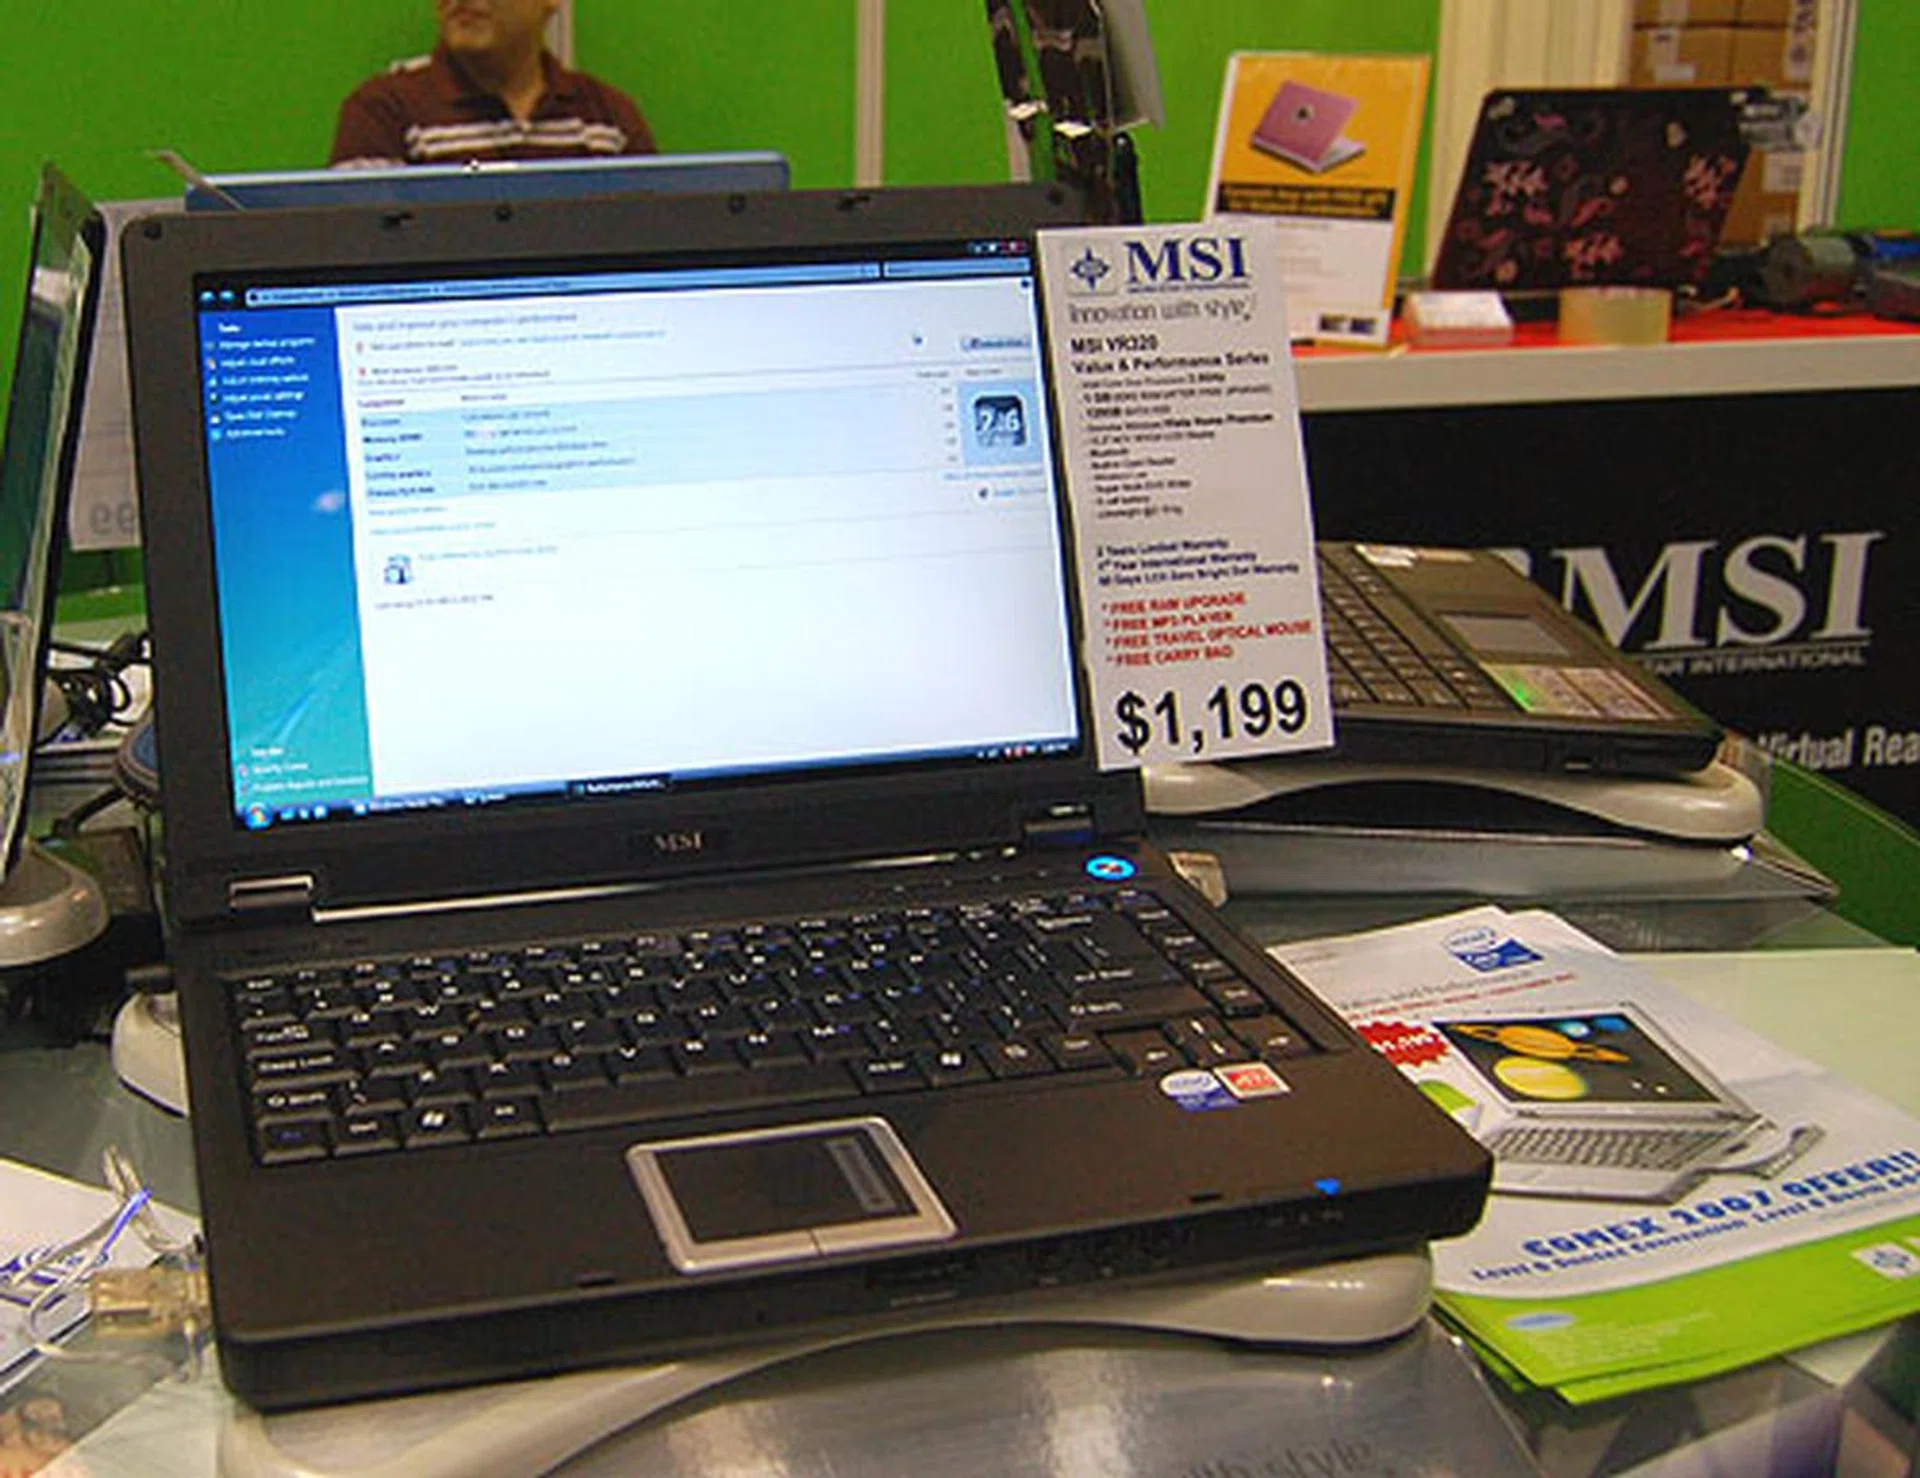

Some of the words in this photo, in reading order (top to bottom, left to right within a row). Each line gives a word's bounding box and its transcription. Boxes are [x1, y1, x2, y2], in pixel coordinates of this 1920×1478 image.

[1124, 237, 1250, 283] MSI
[1071, 337, 1102, 354] MSI
[1072, 360, 1114, 375] Value
[1117, 358, 1129, 372] &
[1133, 355, 1222, 372] Performance
[1226, 352, 1269, 367] Series
[1182, 538, 1230, 551] Warranty
[1141, 555, 1207, 569] International
[1210, 551, 1258, 565] Warranty
[1252, 562, 1301, 576] Warranty
[1550, 531, 1887, 650] MSI
[1110, 599, 1147, 615] FREE
[1182, 592, 1247, 609] UPGRADE
[1112, 617, 1148, 632] FREE
[1181, 610, 1234, 626] PLAYER
[1113, 634, 1149, 649] FREE
[1153, 629, 1206, 647] TRAVEL
[1207, 624, 1263, 642] OPTICAL
[1265, 618, 1313, 636] MOUSE
[1116, 652, 1152, 666] FREE
[1154, 647, 1200, 664] CARRY
[1689, 648, 1866, 674] INTERNATIONAL
[1115, 678, 1309, 756] $1,199
[1522, 1217, 1666, 1257] COMEX
[1668, 1188, 1773, 1226] 2007
